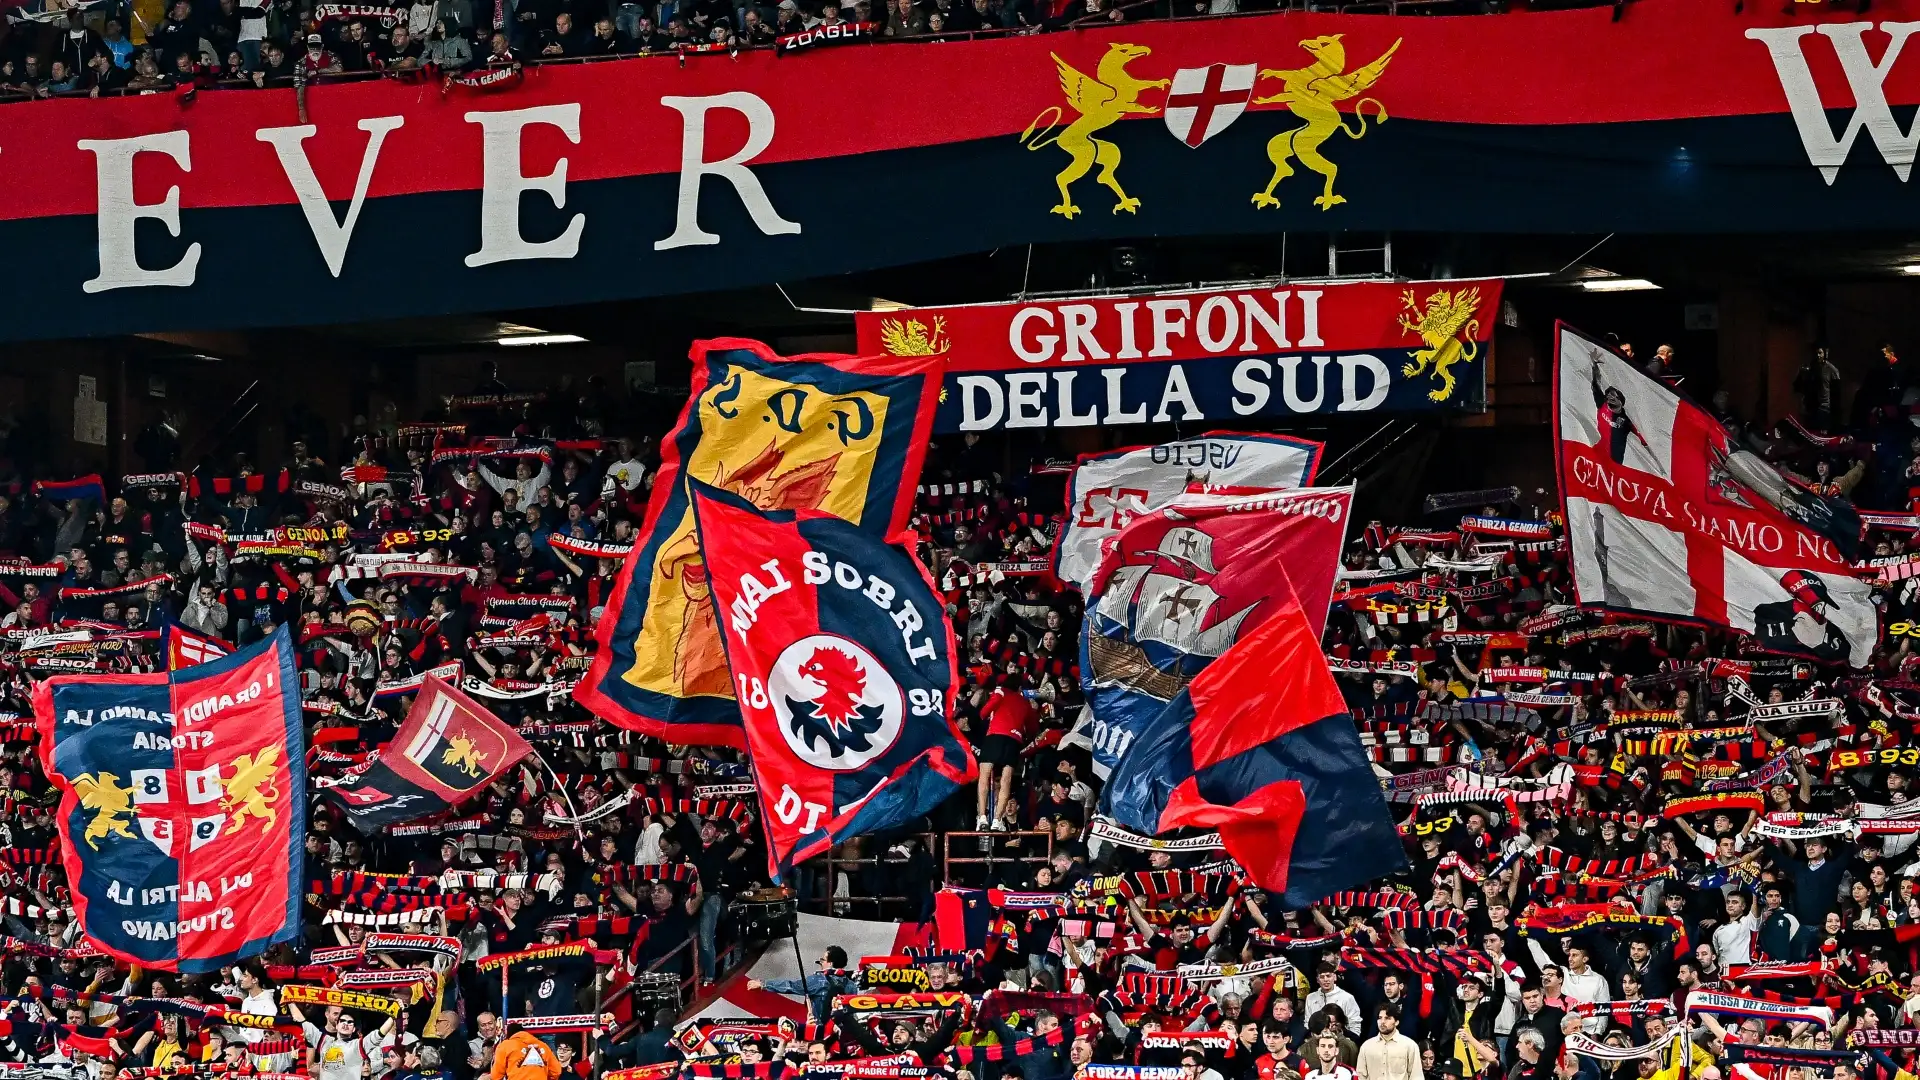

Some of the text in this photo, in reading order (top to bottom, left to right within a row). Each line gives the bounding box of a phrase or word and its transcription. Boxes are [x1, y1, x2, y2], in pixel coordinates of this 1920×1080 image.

[784, 24, 860, 49] ZOAGLI
[481, 67, 512, 85] GENOA
[1008, 289, 1325, 363] GRIFONI
[956, 353, 1392, 431] DELLA SUD
[127, 473, 176, 484] GENOA
[302, 481, 346, 499] GENOA
[1477, 518, 1539, 533] FORZA GENOA
[1684, 501, 1784, 553] SIAMO
[1796, 531, 1845, 563] NO
[287, 527, 329, 542] GENOA
[564, 537, 634, 554] FORZA GENOA
[1030, 563, 1049, 571] GENO
[1869, 555, 1908, 568] GENOA
[489, 596, 515, 607] Genoa
[517, 595, 537, 606] Club
[731, 550, 937, 667] MAI SOBRI
[480, 614, 505, 627] Genoa
[8, 627, 50, 640] GENOA
[480, 634, 541, 642] GENOA
[37, 657, 96, 669] GENOA
[1493, 668, 1595, 681] YOU'LL NEVER WALK ALONE
[739, 672, 769, 709] 18
[1519, 693, 1563, 704] FORZA GENOA
[1787, 703, 1831, 716] CLUB
[554, 723, 589, 733] GENOA
[1880, 749, 1919, 765] 93
[1702, 765, 1718, 780] 12
[774, 783, 828, 836] DI
[1772, 812, 1797, 823] NEVER
[392, 820, 481, 838] BUCANIERI ROSSOBLU
[1097, 823, 1151, 846] Ponente
[1763, 825, 1787, 836] PER
[1008, 895, 1052, 905] GRIFONI
[1647, 915, 1665, 926] TE
[367, 935, 429, 949] Gradinata
[312, 950, 345, 961] FOSSA
[346, 971, 376, 982] FOSSA
[377, 971, 391, 981] DEI
[1179, 966, 1218, 978] nente
[281, 985, 401, 1017] ALE' GENOA
[1709, 994, 1742, 1007] FOSSA
[1144, 1036, 1179, 1049] ORZA
[1853, 1029, 1920, 1046] GENO
[859, 1067, 887, 1076] PADRE
[889, 1067, 898, 1075] IN
[900, 1067, 928, 1076] FIGLIO
[1088, 1066, 1185, 1080] FORZA GENOA
